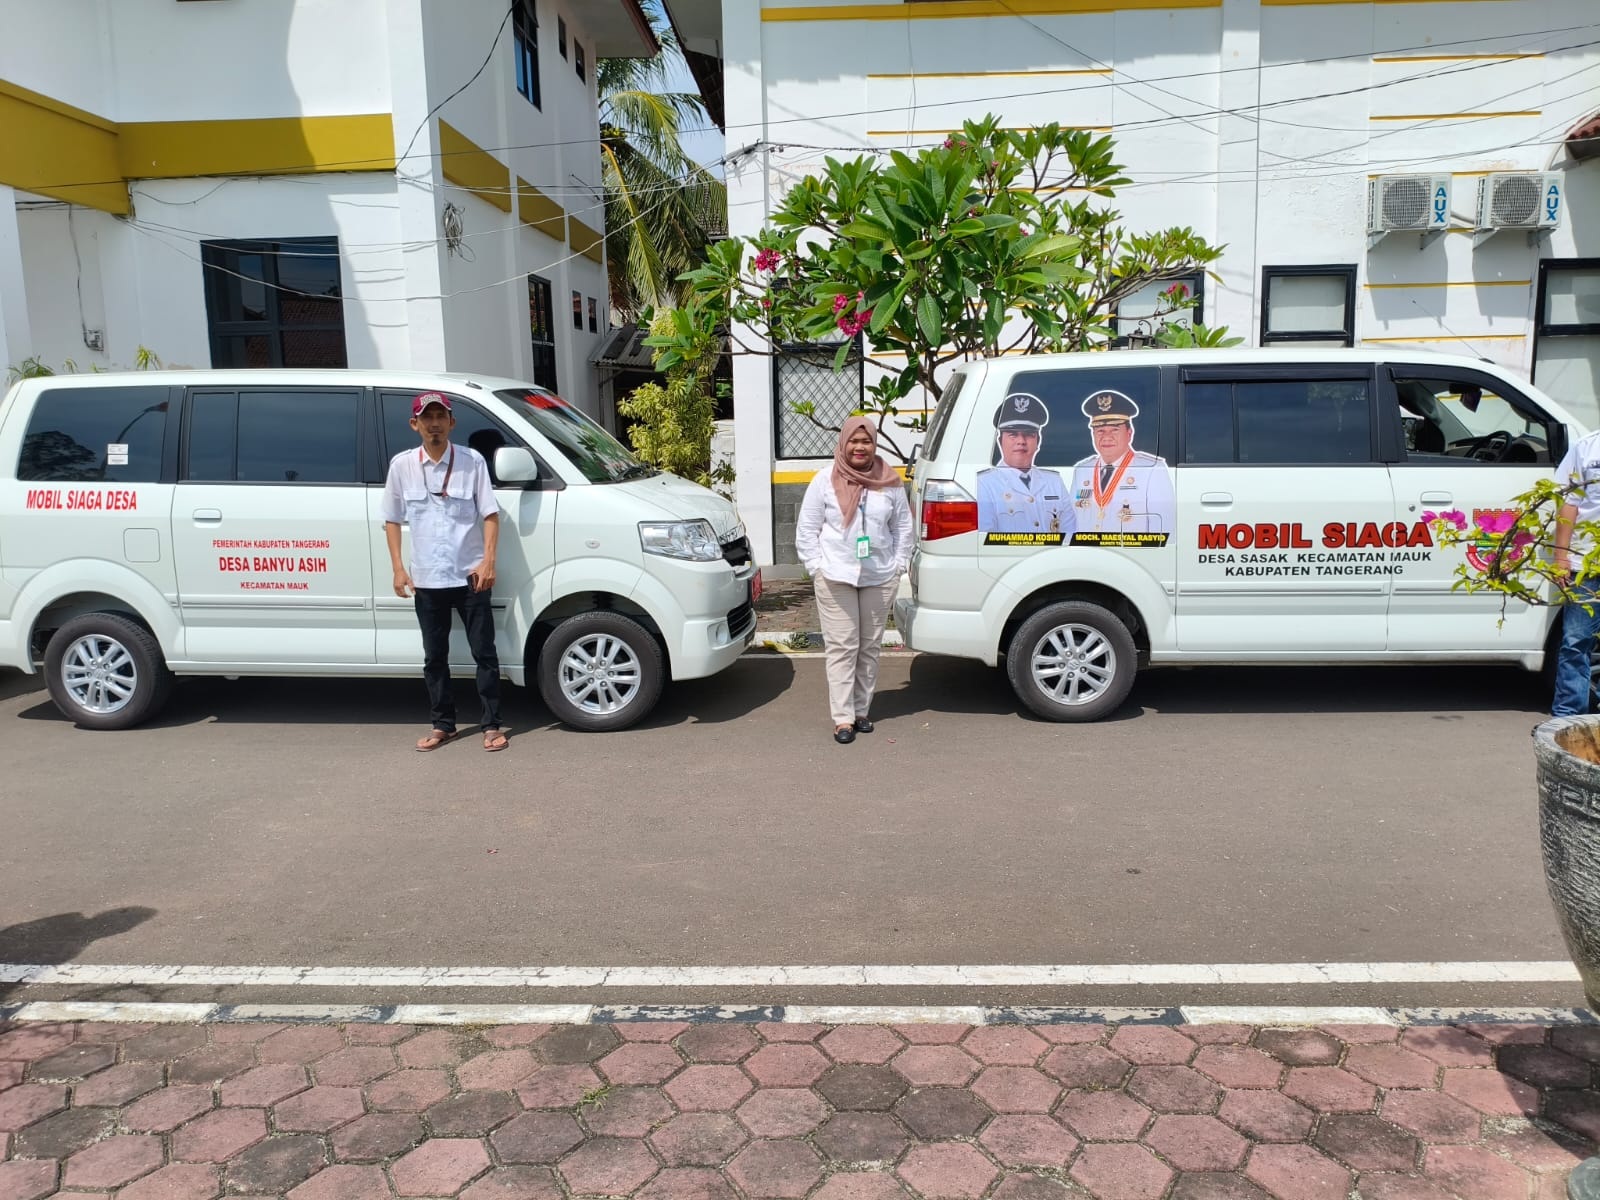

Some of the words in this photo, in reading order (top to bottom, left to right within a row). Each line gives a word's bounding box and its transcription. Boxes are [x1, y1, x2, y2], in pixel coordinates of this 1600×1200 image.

[1434, 187, 1448, 223] AUX
[1546, 185, 1560, 221] AUX
[27, 490, 63, 510] MOBIL
[66, 491, 103, 510] SIAGA
[105, 491, 137, 510] DESA
[212, 540, 252, 549] PEMERINTAH
[253, 540, 291, 549] KABUPATEN
[292, 540, 330, 549] TANGERANG
[1198, 523, 1313, 550] MOBIL
[1321, 522, 1435, 549] SIAGA
[219, 556, 251, 573] DESA
[253, 557, 295, 573] BANYU
[298, 557, 327, 573] ASIH
[1198, 553, 1235, 563] DESA
[1240, 553, 1288, 563] SASAK
[1297, 552, 1385, 563] KECAMATAN
[1390, 552, 1432, 562] MAUK
[1225, 566, 1310, 577] KABUPATEN
[1315, 565, 1404, 576] TANGERANG
[240, 581, 285, 590] KECAMATAN
[287, 581, 308, 590] MAUK
